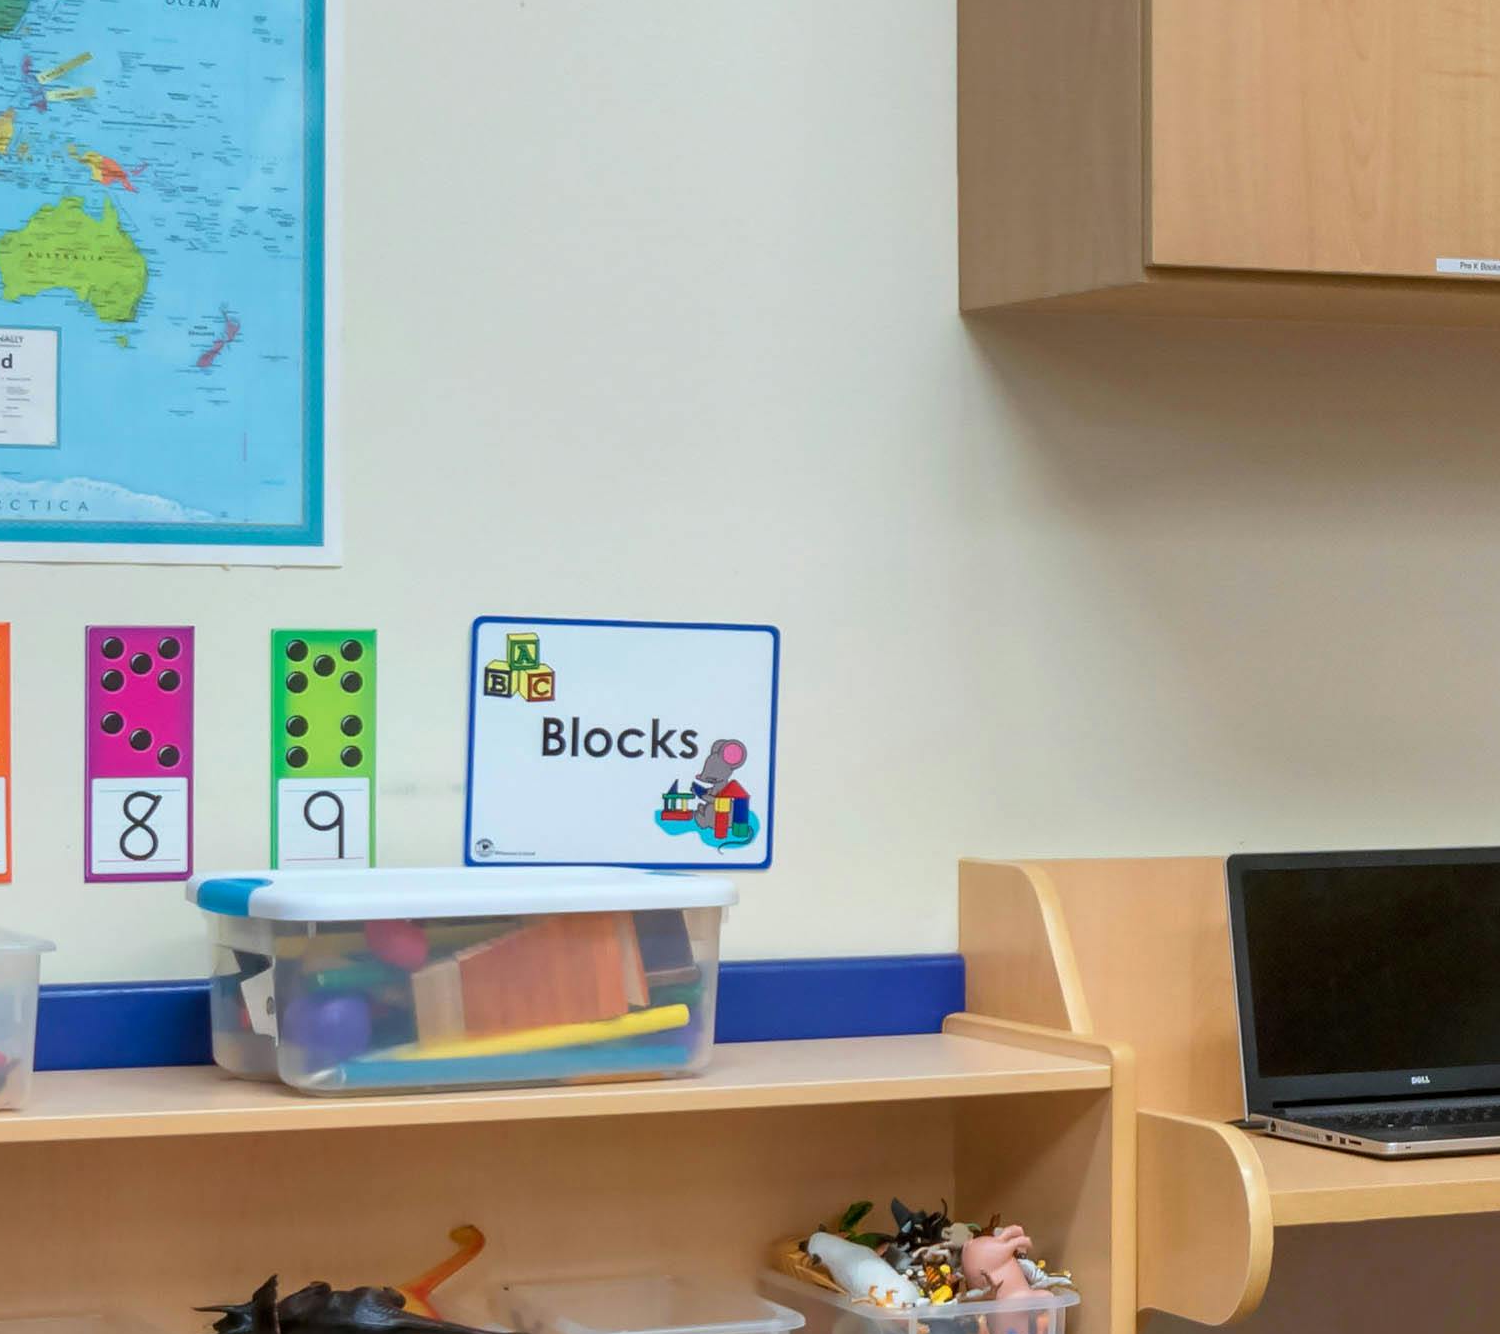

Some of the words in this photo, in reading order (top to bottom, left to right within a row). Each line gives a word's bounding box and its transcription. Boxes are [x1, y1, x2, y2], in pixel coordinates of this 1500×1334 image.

[27, 252, 104, 262] AUSTRALIA
[517, 644, 532, 665] A
[490, 673, 508, 693] B
[532, 678, 551, 697] C
[541, 716, 699, 760] Blocks
[119, 791, 163, 862] 8
[302, 790, 346, 860] 9
[1411, 1076, 1431, 1085] DELL
